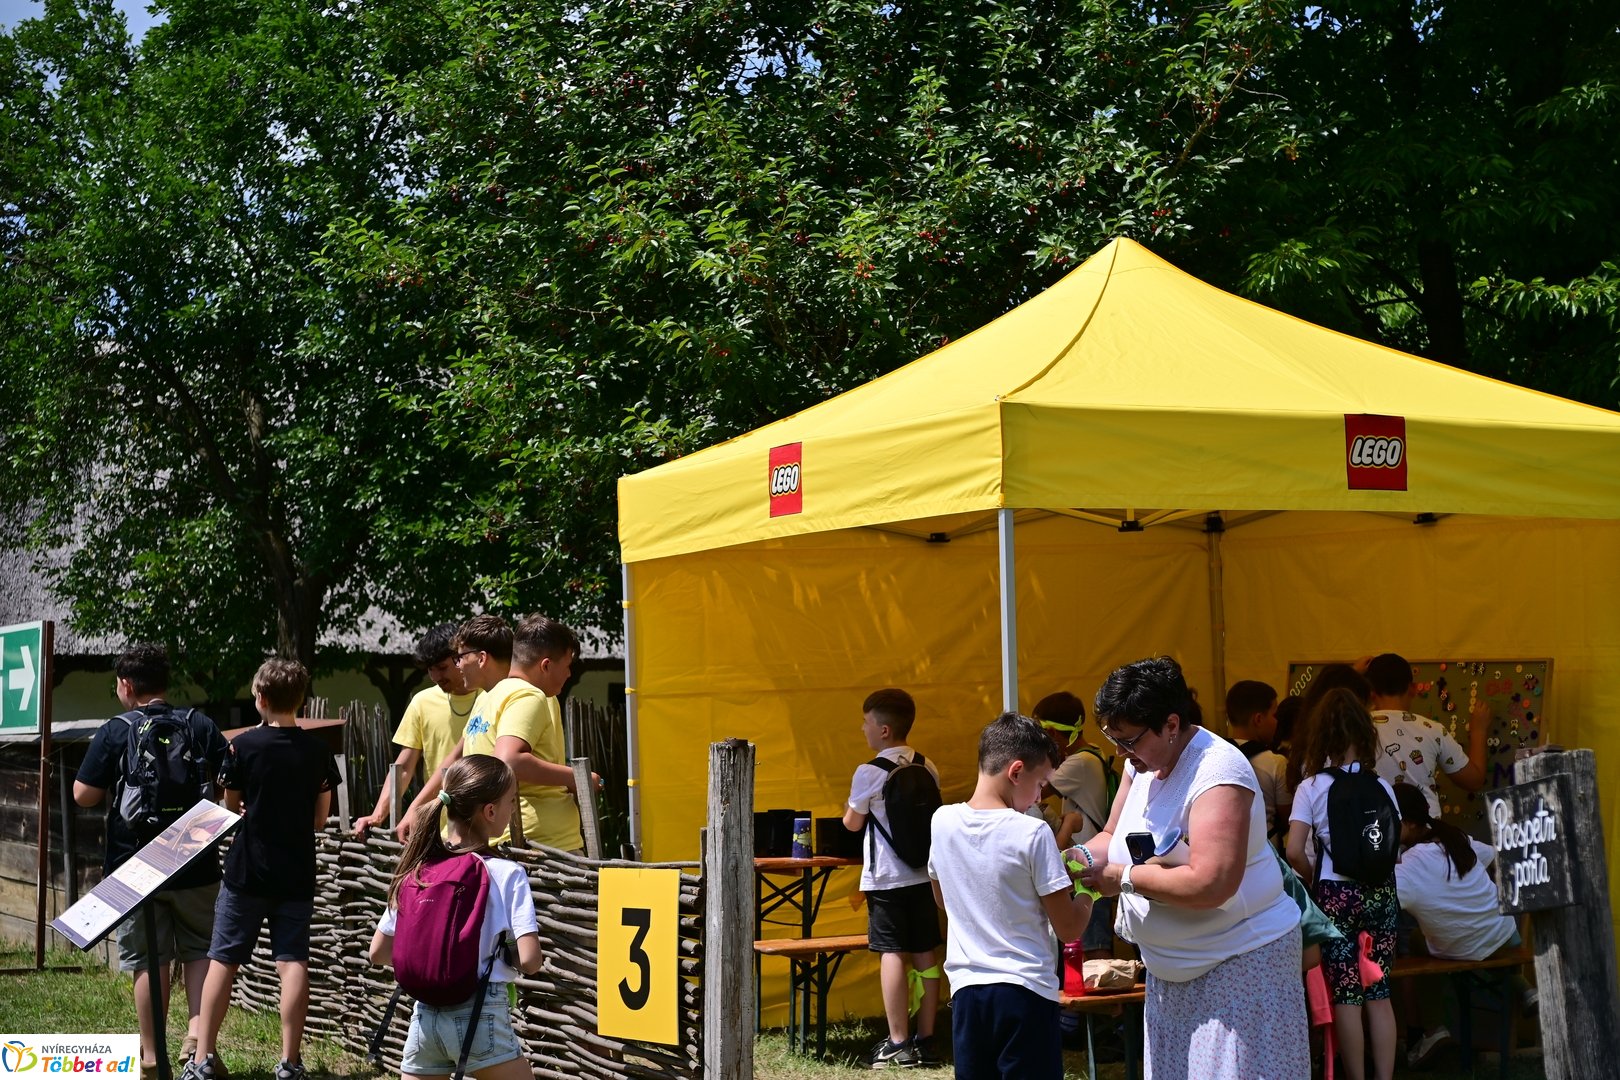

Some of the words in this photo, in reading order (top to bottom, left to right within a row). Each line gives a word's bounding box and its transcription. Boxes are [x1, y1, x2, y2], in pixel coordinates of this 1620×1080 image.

[1349, 435, 1404, 469] LEGO
[771, 462, 800, 497] LEGO
[1512, 845, 1550, 906] porta
[618, 907, 652, 1011] 3
